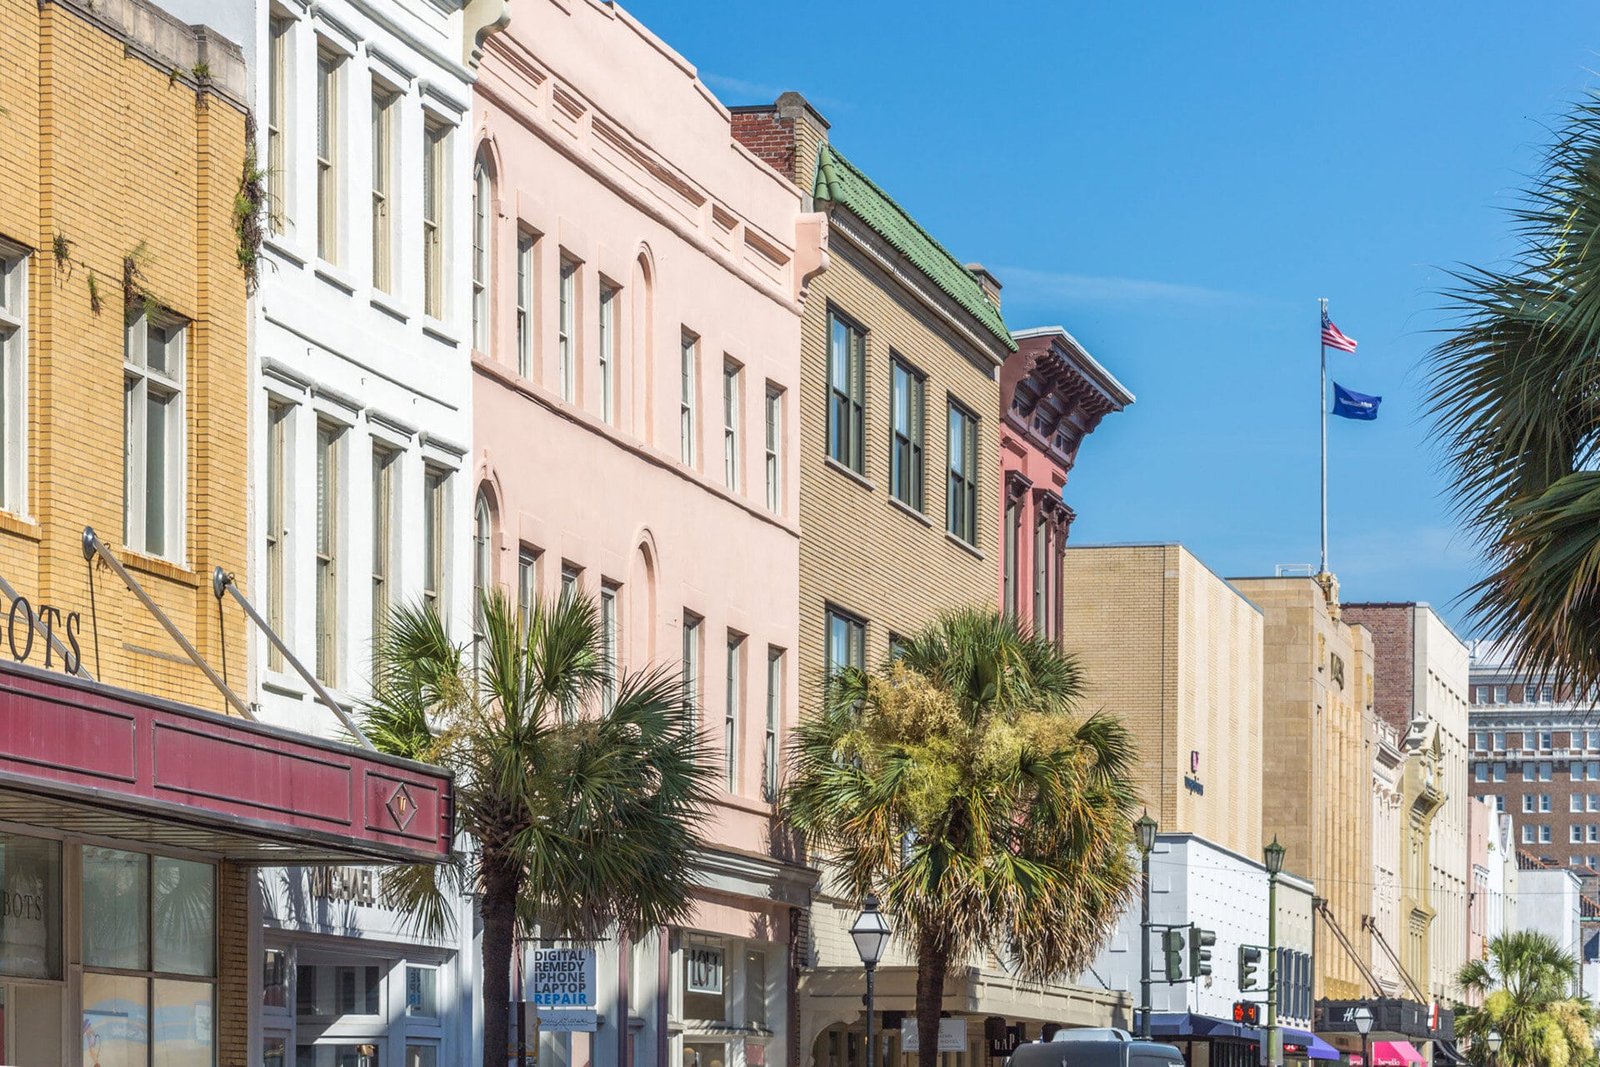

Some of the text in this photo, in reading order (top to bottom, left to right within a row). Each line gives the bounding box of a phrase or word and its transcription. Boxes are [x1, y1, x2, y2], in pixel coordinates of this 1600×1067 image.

[0, 596, 80, 675] OTS
[535, 950, 585, 961] DIGITAL
[535, 961, 584, 972] REMEDY
[691, 949, 721, 988] LOFT
[535, 972, 585, 982] IPHONE
[535, 983, 586, 993] LAPTOP
[535, 993, 587, 1004] REPAIR
[994, 1033, 1016, 1051] GAP
